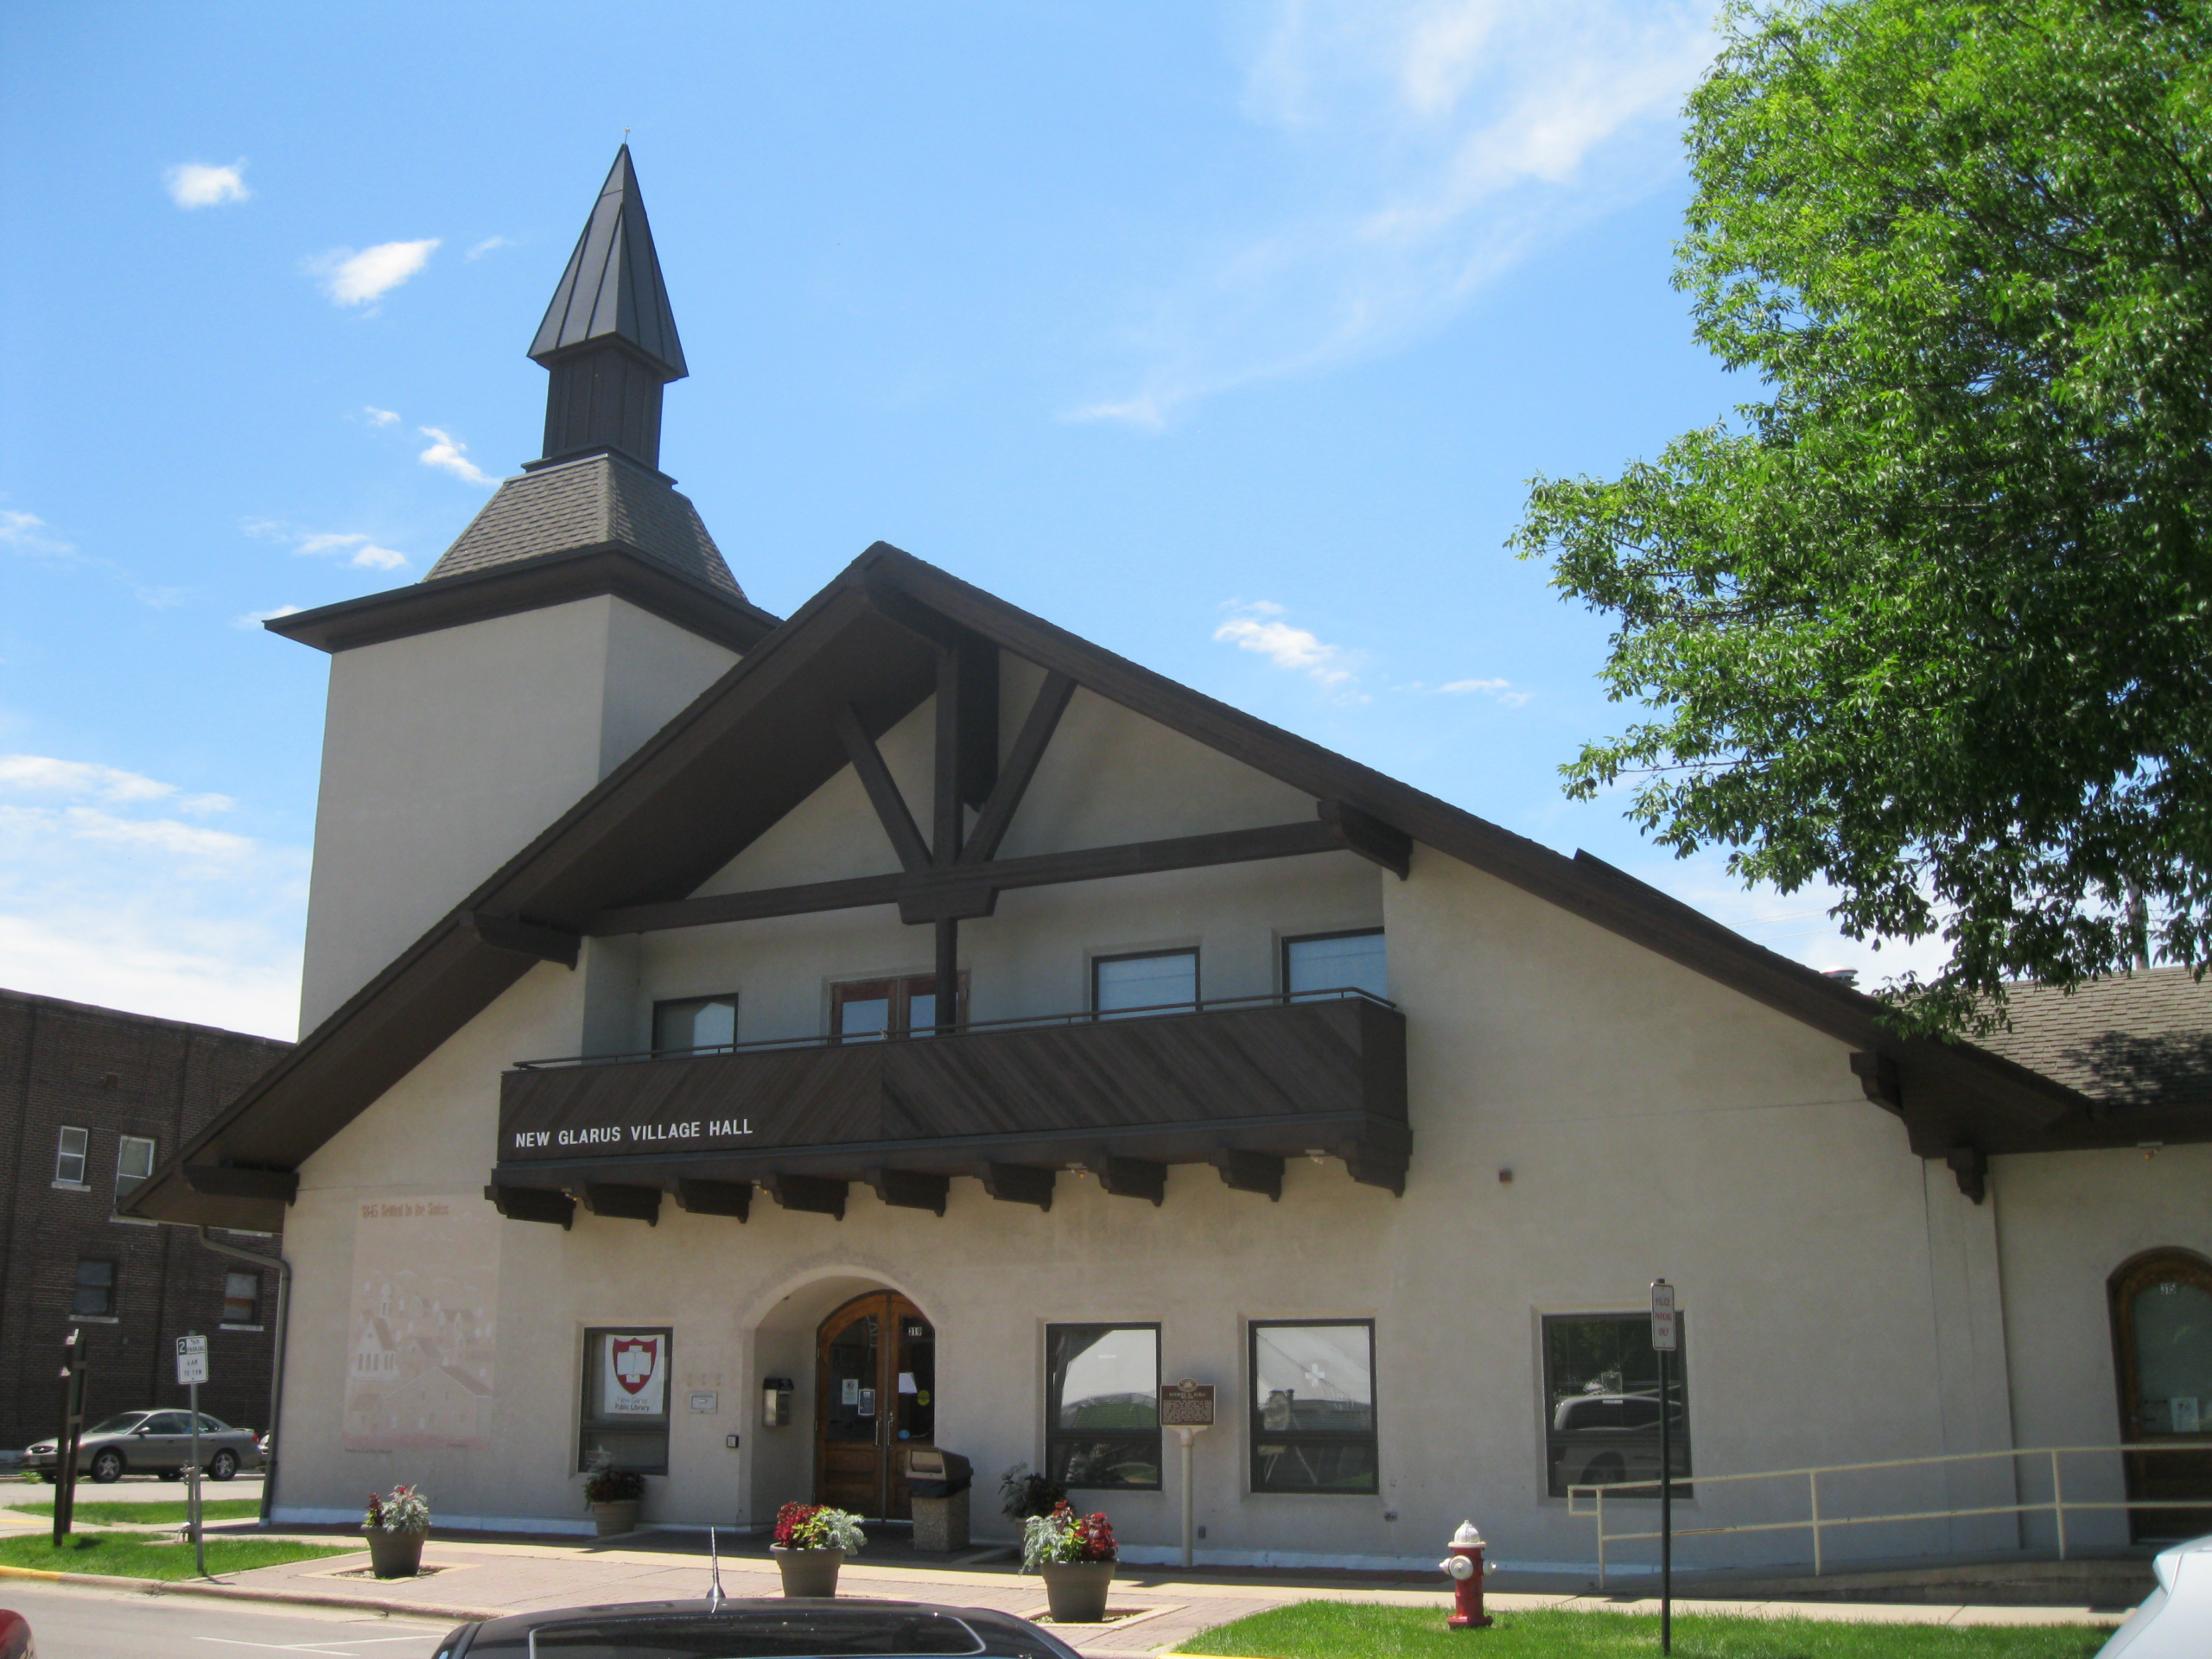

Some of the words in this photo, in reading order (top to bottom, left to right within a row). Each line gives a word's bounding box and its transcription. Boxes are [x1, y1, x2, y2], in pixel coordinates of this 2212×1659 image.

[516, 1131, 550, 1147] NEW
[558, 1126, 621, 1145] GLARUS
[631, 1122, 701, 1141] VILLAGE
[709, 1118, 753, 1136] HALL
[1656, 1297, 1670, 1306] POLICE
[1655, 1312, 1673, 1322] PARKING
[1658, 1327, 1669, 1337] ONLY
[179, 1341, 185, 1352] 2
[630, 1403, 650, 1412] Library
